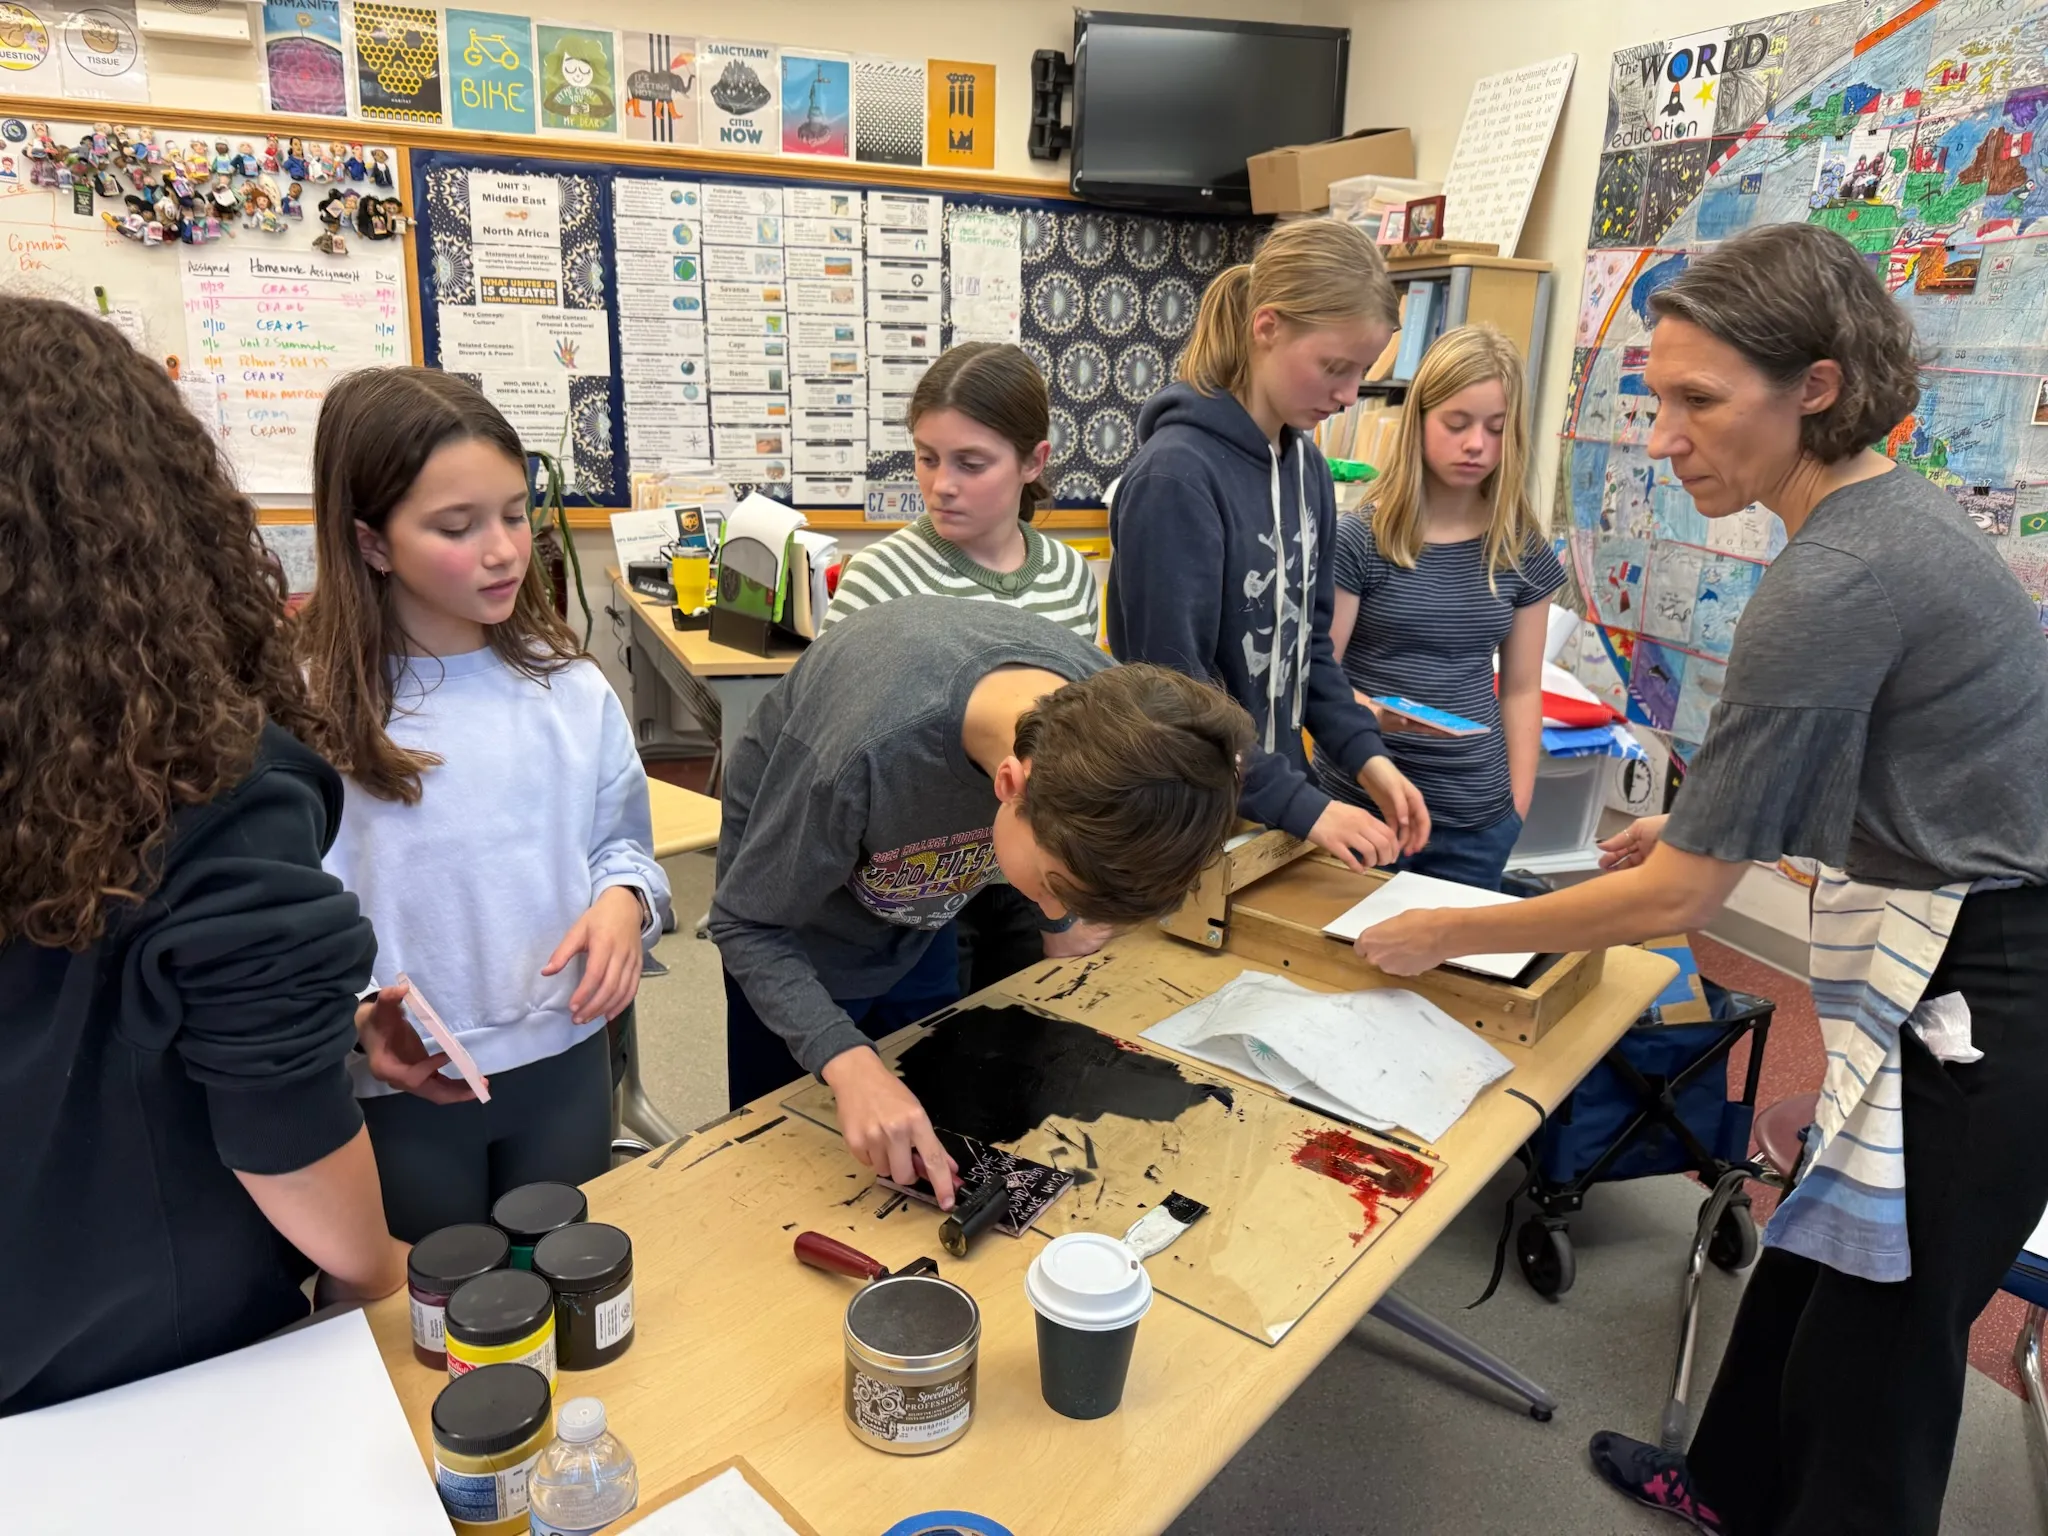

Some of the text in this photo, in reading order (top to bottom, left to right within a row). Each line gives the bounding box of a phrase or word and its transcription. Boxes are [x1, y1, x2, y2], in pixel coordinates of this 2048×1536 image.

[0, 51, 41, 61] UESTION
[708, 44, 769, 60] SANCTUARY
[87, 56, 120, 66] TISSUE
[1619, 33, 1769, 88] The WORLD
[1515, 65, 1549, 83] beginning
[634, 81, 670, 91] GETTING
[461, 78, 525, 112] BIKE
[729, 117, 754, 128] CITIES
[720, 128, 763, 145] NOW
[1611, 120, 1698, 149] education
[497, 182, 531, 191] UNIT 3:
[482, 193, 547, 206] Middle East
[483, 226, 550, 238] North Africa
[8, 233, 71, 252] Common
[19, 252, 52, 271] Era
[188, 257, 398, 283] Assigned Homework Assignment Due
[482, 278, 510, 287] WHAT
[511, 279, 542, 288] UNITES
[719, 285, 751, 294] Savanna
[483, 286, 556, 299] IS GREATER
[202, 318, 226, 337] 11/10
[728, 341, 747, 350] Cape
[2015, 479, 2027, 490] 76
[868, 492, 885, 513] CZ
[901, 836, 949, 856] COLLEGE
[905, 1386, 969, 1411] PROFESSIONAL
[918, 1381, 960, 1404] Speedball
